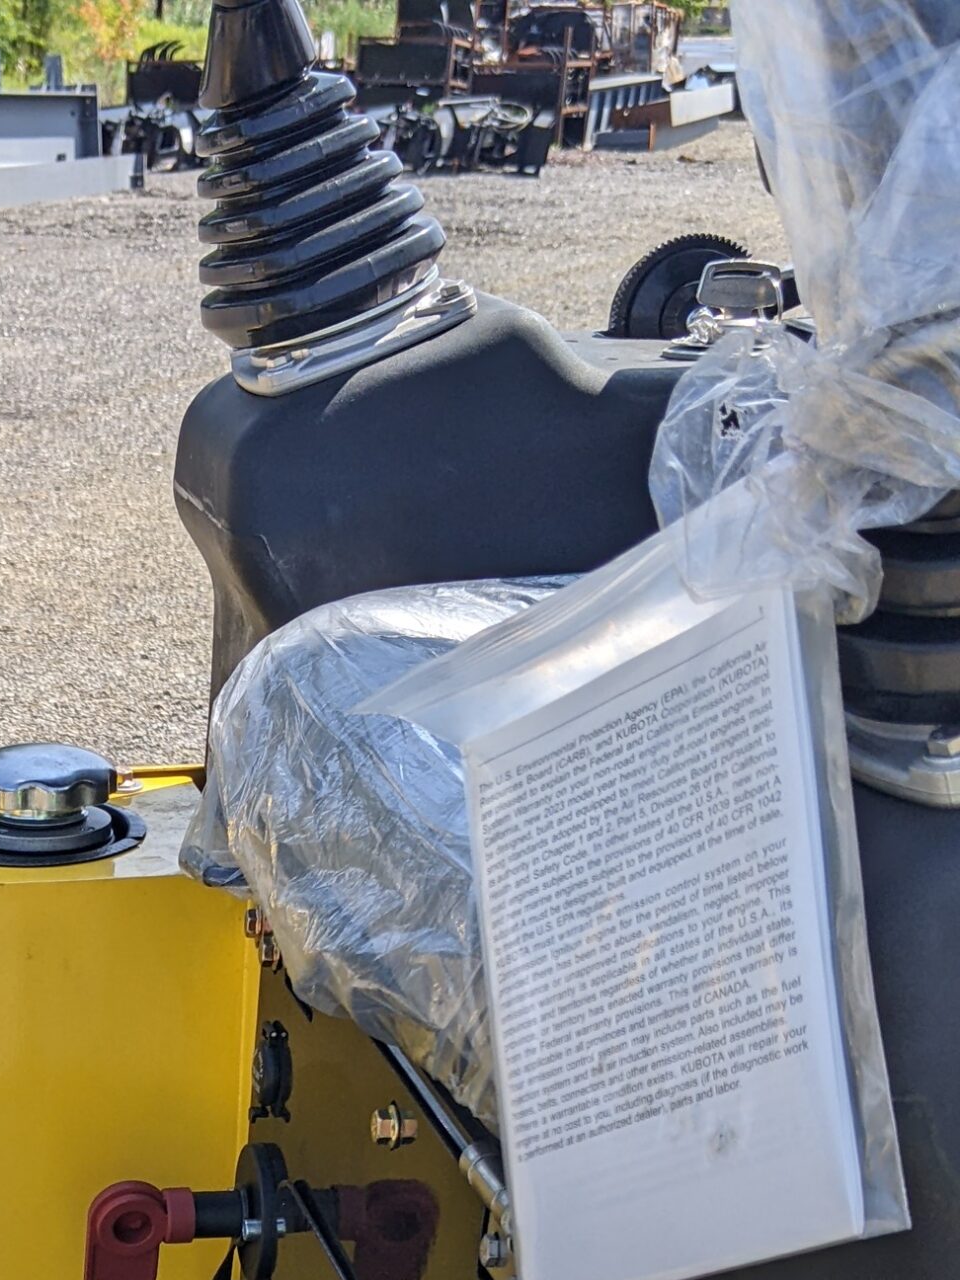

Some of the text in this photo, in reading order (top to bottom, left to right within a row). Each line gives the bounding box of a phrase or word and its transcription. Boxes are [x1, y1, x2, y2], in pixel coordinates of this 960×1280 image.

[579, 719, 621, 745] Protection
[625, 701, 656, 722] Agency
[710, 651, 750, 678] California
[590, 745, 622, 768] Federal
[647, 714, 688, 740] California
[693, 692, 731, 717] Emission
[736, 671, 769, 695] Control
[617, 714, 656, 740] KUBOTA
[662, 686, 714, 717] Corporation
[719, 654, 770, 690] (KUBOTA)
[568, 786, 593, 807] model
[621, 763, 646, 782] heavy
[711, 715, 744, 739] engines
[576, 791, 615, 817] equipped
[658, 749, 706, 779] California's
[594, 752, 634, 780] non-road
[638, 774, 686, 803] Resources
[691, 758, 716, 778] Board
[651, 789, 685, 812] Division
[732, 746, 777, 774] California
[592, 861, 622, 883] subject
[656, 827, 701, 857] provisions
[732, 803, 752, 821] CFR
[759, 789, 781, 808] 1042
[605, 835, 650, 865] provisions
[709, 798, 729, 816] 1039
[735, 779, 769, 804] subpart
[634, 816, 660, 835] states
[616, 838, 785, 916] emission control system your
[656, 894, 685, 917] period
[728, 866, 753, 885] listed
[758, 853, 787, 872] below
[575, 948, 595, 963] been
[745, 868, 788, 894] improper
[621, 927, 683, 959] modifications
[702, 911, 722, 929] your
[591, 961, 636, 986] applicable
[671, 936, 699, 955] states
[600, 973, 645, 998] regardless
[662, 952, 697, 973] whether
[718, 925, 761, 952] individual
[608, 987, 643, 1009] enacted
[648, 971, 687, 993] warranty
[693, 951, 740, 979] provisions
[770, 930, 794, 947] differ
[693, 969, 735, 992] emission
[741, 951, 783, 974] warranty
[587, 1026, 626, 1050] provinces
[598, 1041, 627, 1059] system
[654, 1019, 685, 1038] include
[691, 1008, 713, 1027] parts
[719, 997, 741, 1014] such
[619, 1045, 657, 1066] induction
[722, 1005, 761, 1029] included
[766, 998, 786, 1013] may
[627, 1063, 647, 1078] other
[652, 1034, 725, 1069] emission-related
[604, 1081, 642, 1102] condition
[682, 1051, 723, 1074] KUBOTA
[749, 1033, 777, 1051] repair
[784, 1024, 806, 1042] your
[615, 1093, 652, 1113] including
[656, 1077, 697, 1099] diagnosis
[732, 1050, 779, 1073] diagnostic
[785, 1039, 807, 1055] work
[589, 1114, 631, 1137] authorized
[670, 1095, 692, 1112] parts
